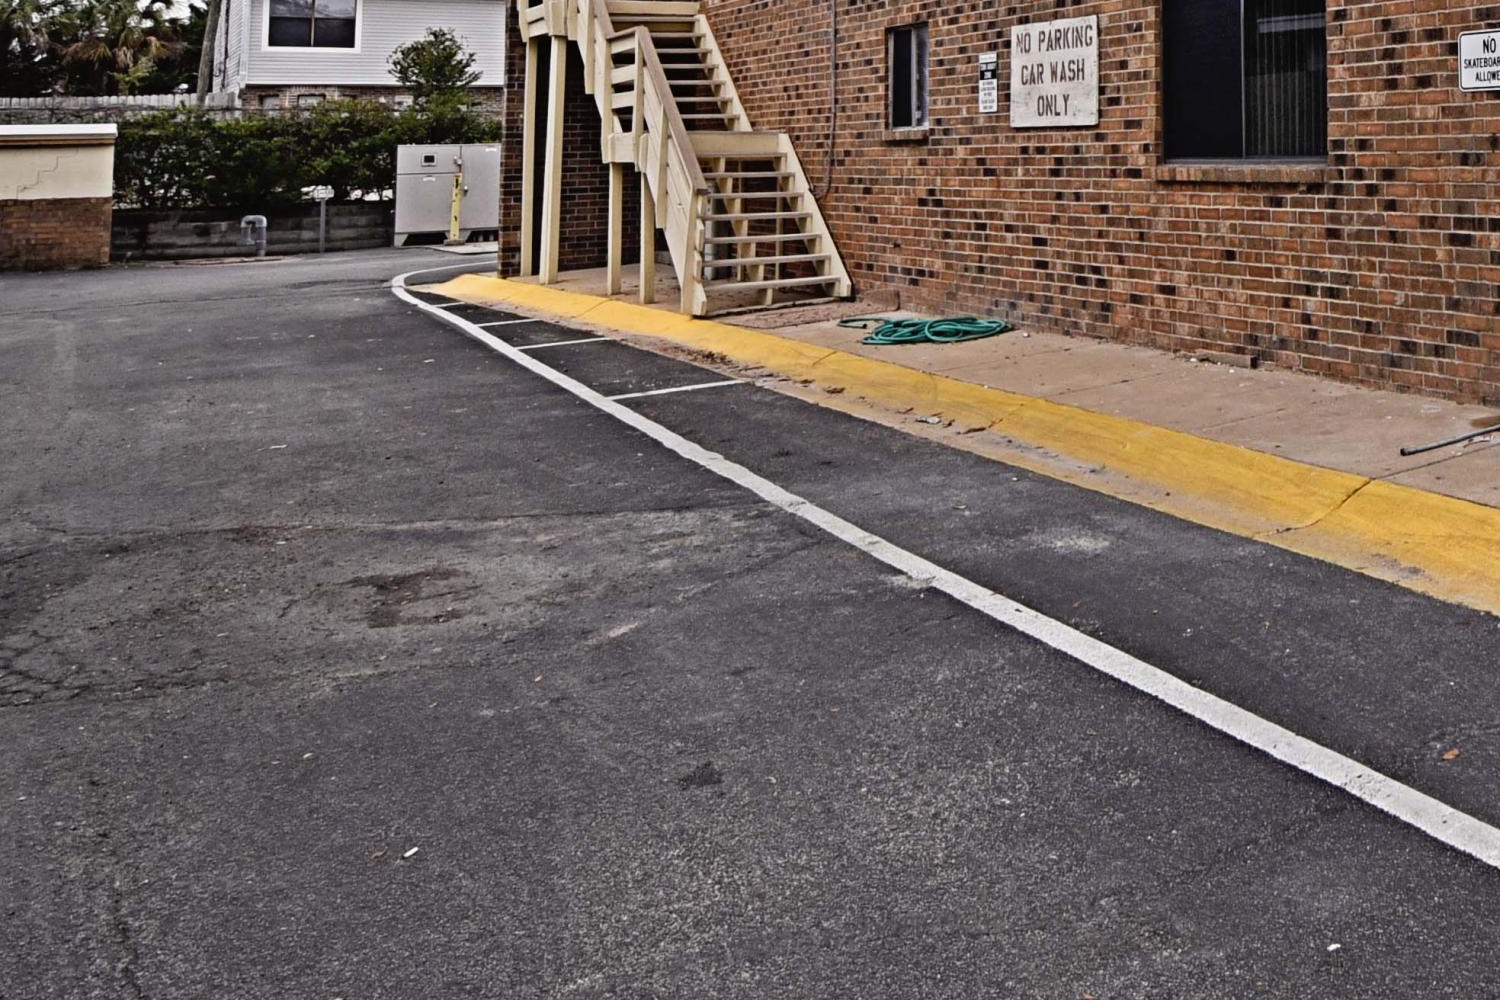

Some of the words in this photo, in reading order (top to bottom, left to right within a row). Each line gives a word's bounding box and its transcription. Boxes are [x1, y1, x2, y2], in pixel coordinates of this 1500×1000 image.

[1016, 32, 1032, 54] NO
[1038, 24, 1094, 54] PARKING
[1482, 37, 1497, 54] NO
[1021, 62, 1045, 86] CAR
[1049, 58, 1086, 84] WASH
[1037, 93, 1071, 117] ONLY
